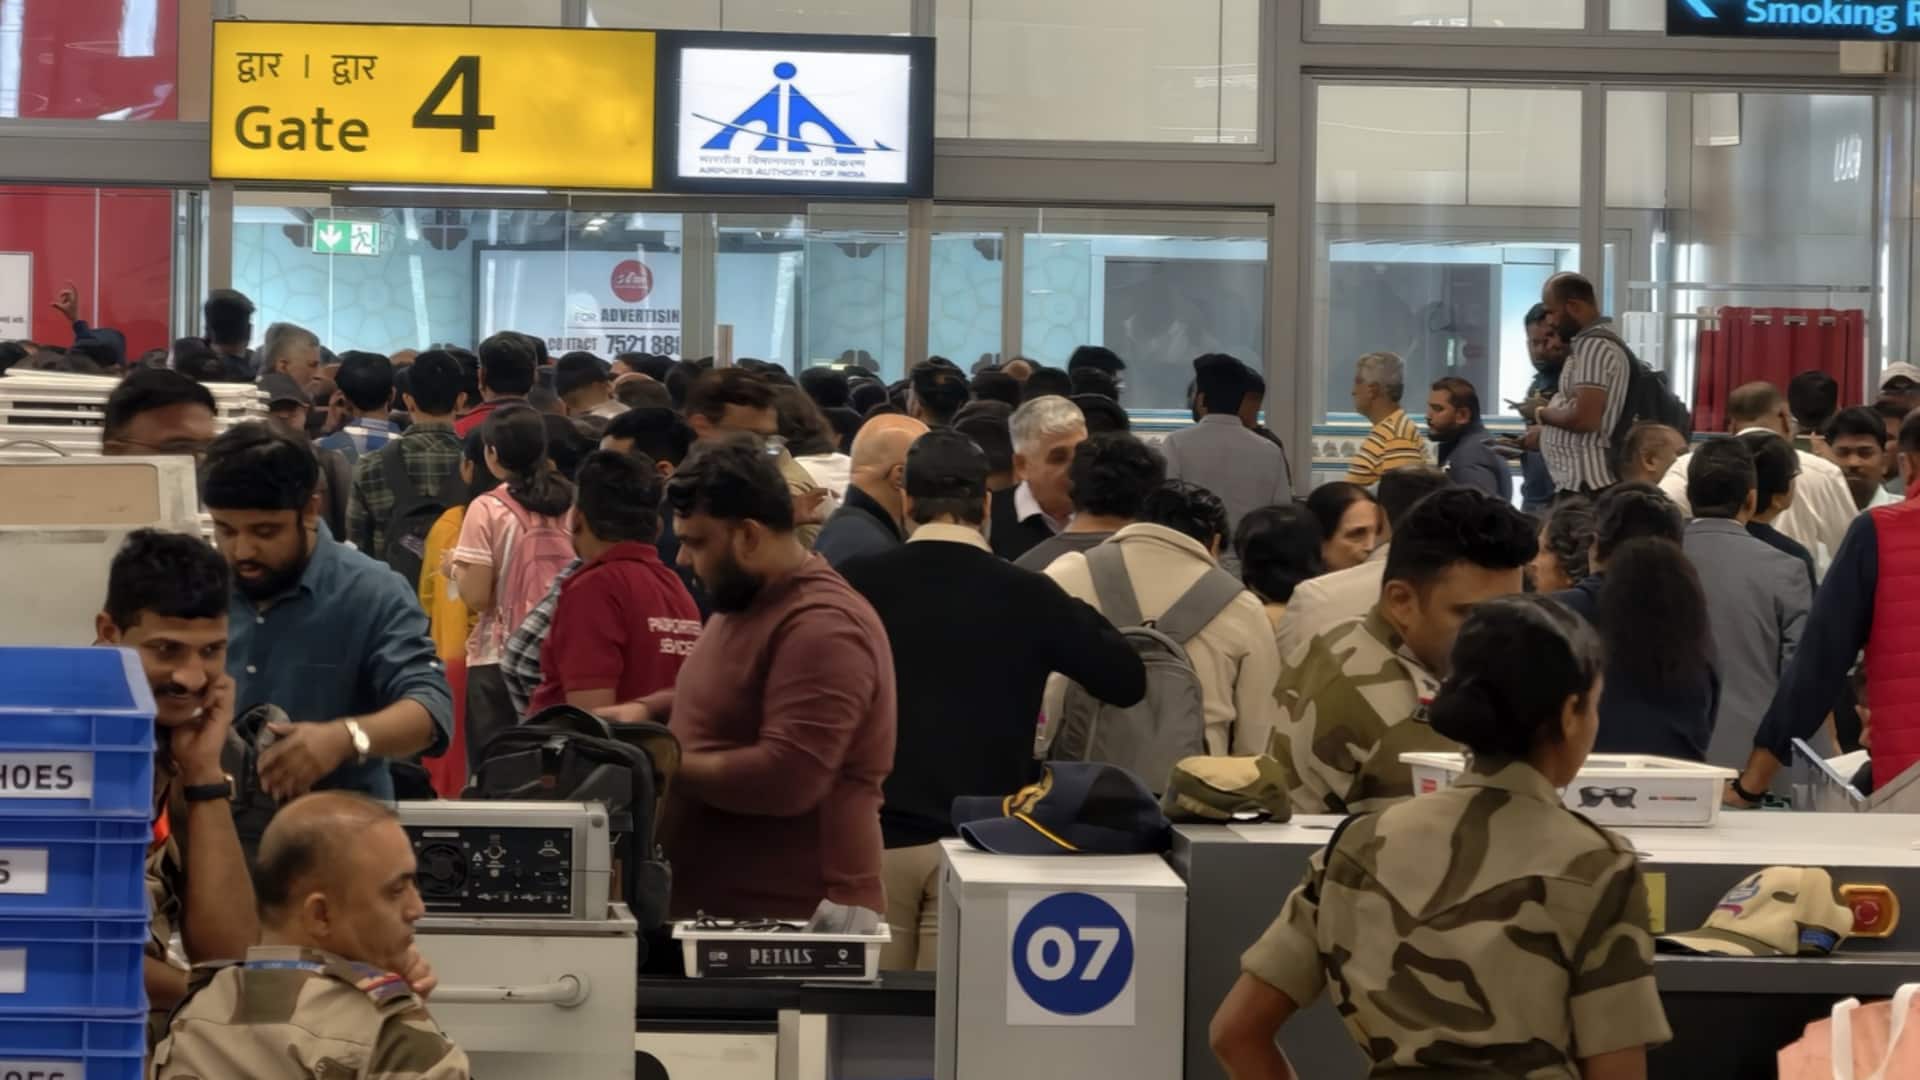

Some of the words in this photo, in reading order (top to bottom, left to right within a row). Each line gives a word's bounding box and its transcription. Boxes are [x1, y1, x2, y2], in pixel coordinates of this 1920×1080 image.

[1746, 0, 1898, 34] Smoking
[236, 52, 283, 83] द्वार
[331, 55, 378, 85] द्वार
[235, 105, 370, 153] Gate
[412, 55, 496, 153] 4
[755, 167, 816, 176] AUTHORITY
[819, 169, 834, 177] OF
[606, 334, 647, 355] 7521
[750, 948, 813, 965] PETALS
[1026, 925, 1120, 981] 07
